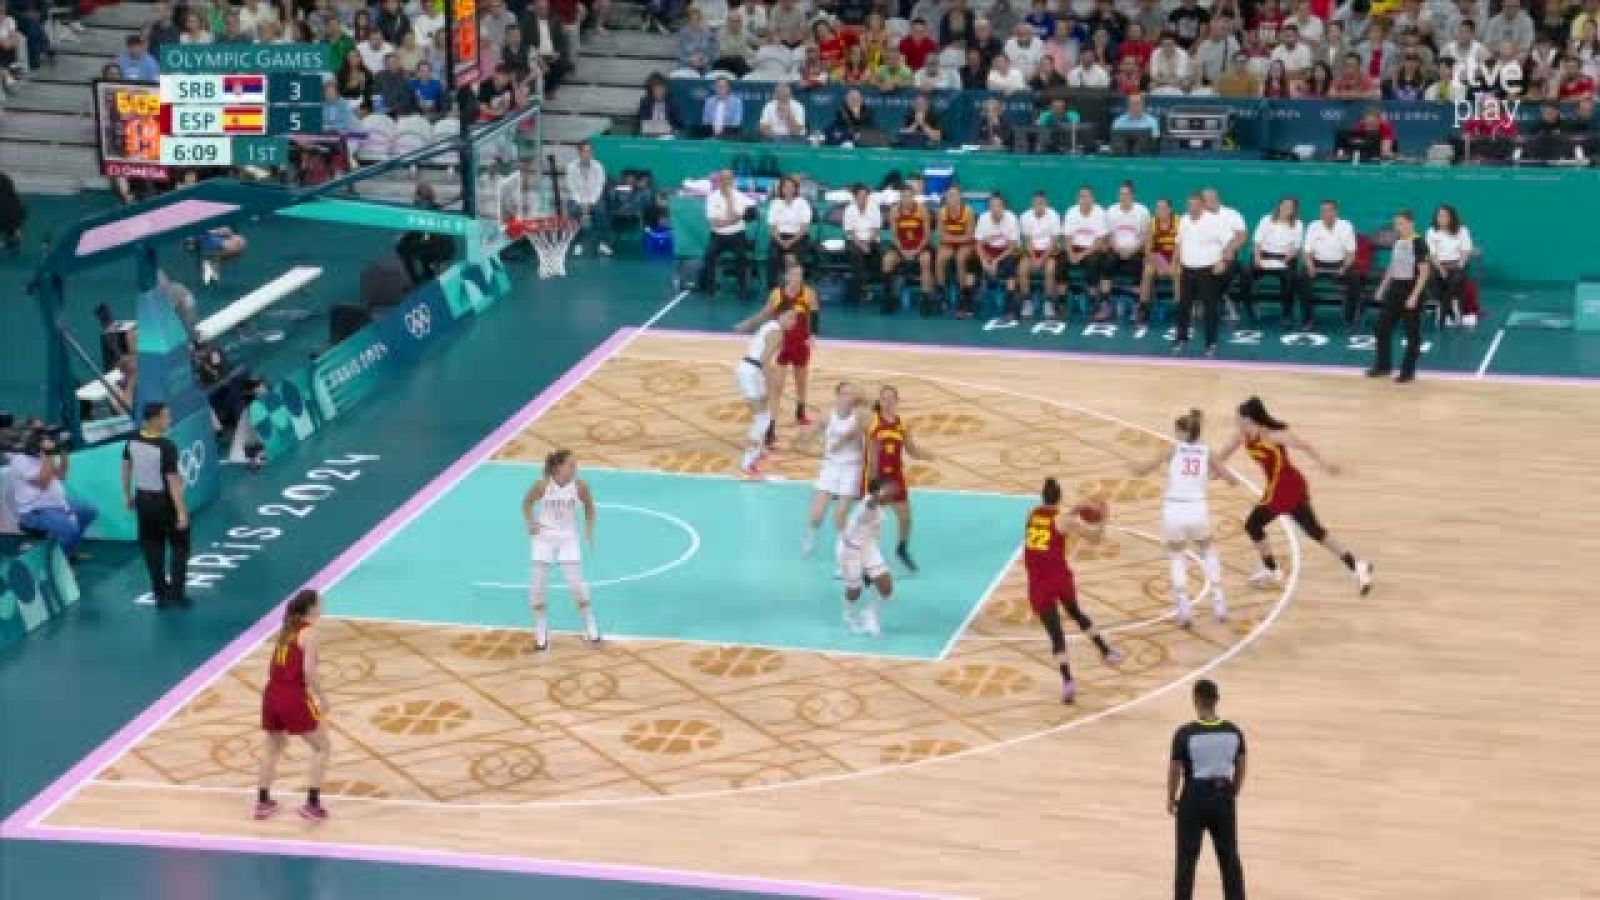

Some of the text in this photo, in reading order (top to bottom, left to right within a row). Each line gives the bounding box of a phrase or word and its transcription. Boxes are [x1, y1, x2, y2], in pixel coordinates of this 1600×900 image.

[1182, 457, 1201, 476] 33
[257, 454, 381, 519] 2024
[1028, 528, 1050, 549] 22
